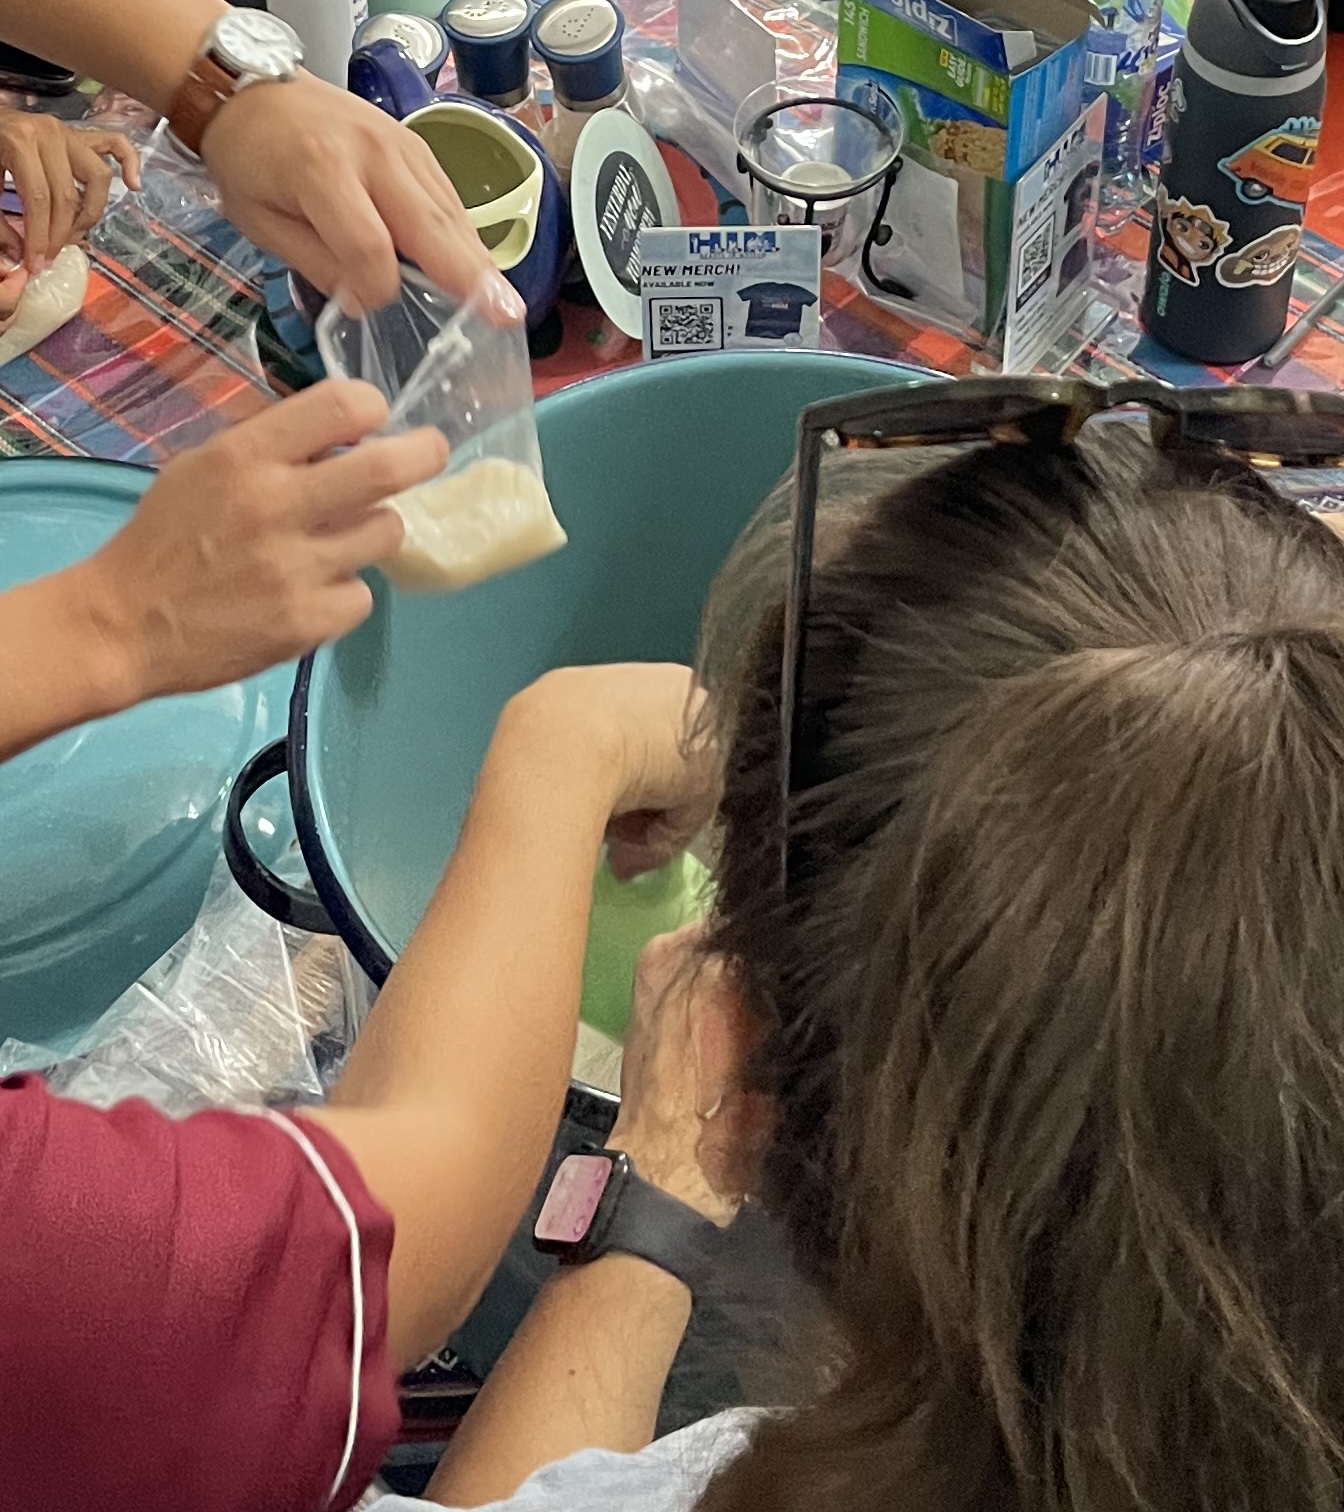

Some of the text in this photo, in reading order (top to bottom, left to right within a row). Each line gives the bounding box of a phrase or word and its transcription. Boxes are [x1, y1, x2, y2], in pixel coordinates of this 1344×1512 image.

[857, 6, 871, 63] SANDWICH
[641, 264, 741, 277] NEW MERCH!
